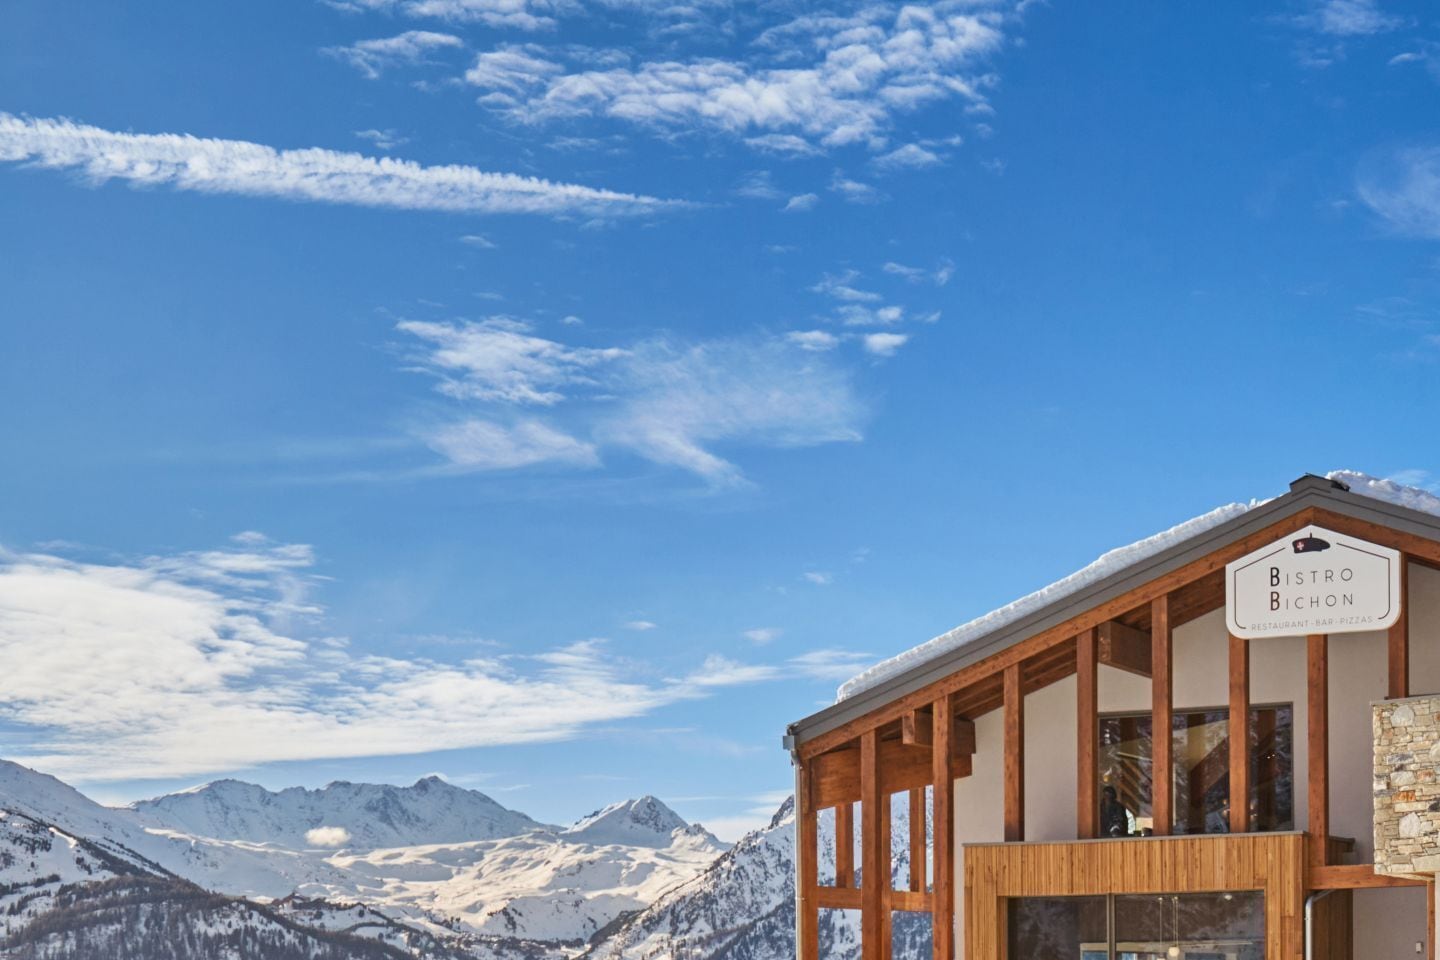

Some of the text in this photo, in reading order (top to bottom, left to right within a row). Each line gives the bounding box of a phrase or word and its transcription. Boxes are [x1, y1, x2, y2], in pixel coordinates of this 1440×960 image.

[1270, 567, 1353, 587] BISTRO
[1270, 591, 1353, 611] BICHON
[1251, 620, 1308, 631] RESTAURANT
[1315, 618, 1334, 626] BAR
[1340, 615, 1373, 625] PIZZAS
